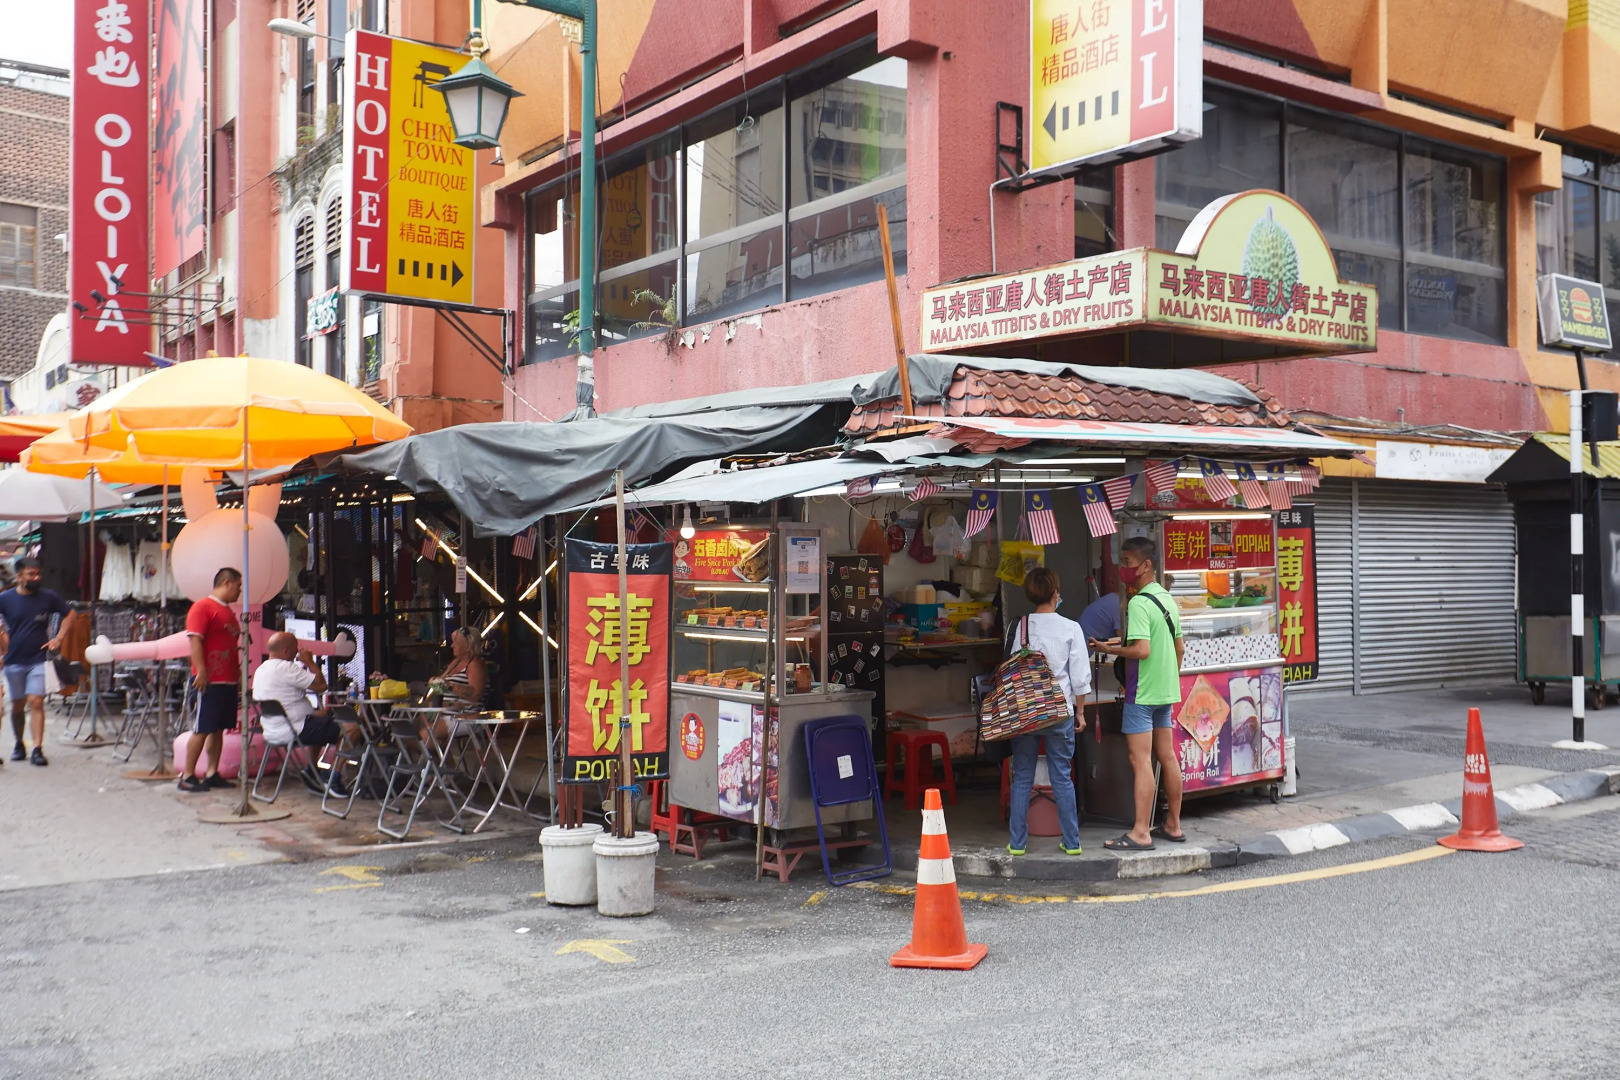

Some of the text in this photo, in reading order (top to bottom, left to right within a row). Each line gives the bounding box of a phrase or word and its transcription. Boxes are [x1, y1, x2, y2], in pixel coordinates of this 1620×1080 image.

[1050, 0, 1111, 46] 唐人街
[1041, 33, 1120, 87] 精品酒店
[401, 118, 455, 143] CHIN
[355, 52, 389, 275] HOTEL
[403, 139, 465, 167] TOWN
[399, 166, 468, 192] BOUTIQUE
[94, 113, 132, 335] OLOIYA
[407, 198, 459, 225] 唐人街
[399, 221, 466, 251] 精品酒店
[931, 261, 1133, 324] 马来西亚唐人街土产店
[1159, 262, 1368, 324] 马来西亚唐人街土产店
[930, 299, 1134, 345] MALAYSIA TITBITS & DRY FRUITS
[1158, 297, 1369, 343] MALAYSIA TITBITS & DRY FRUITS
[1561, 319, 1608, 340] HAMBURGER
[1428, 449, 1456, 458] Fruits
[1279, 512, 1302, 525] 早味
[1168, 530, 1206, 559] 薄饼
[1235, 534, 1270, 553] POPIAH
[1209, 560, 1226, 569] RM6
[585, 593, 653, 752] 薄饼
[1283, 665, 1312, 682] PIAH
[575, 757, 659, 781] POPAH
[1181, 767, 1220, 783] Spring Roll
